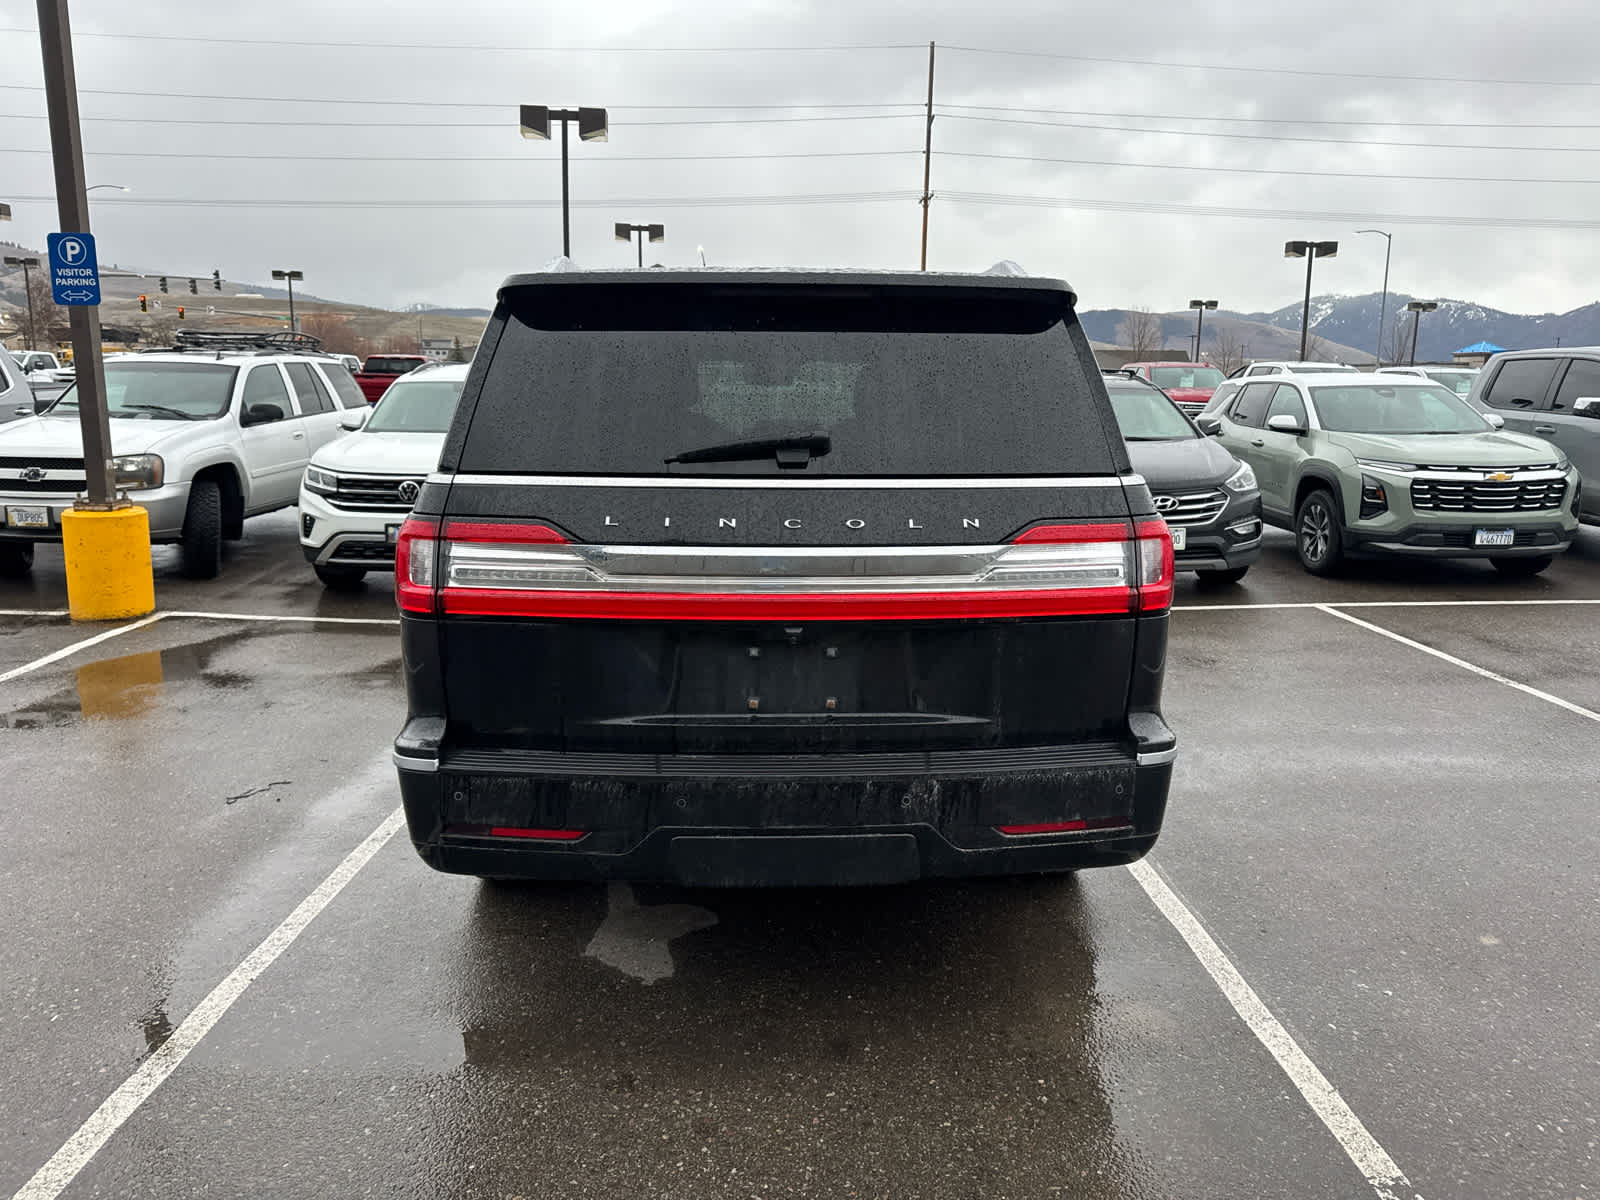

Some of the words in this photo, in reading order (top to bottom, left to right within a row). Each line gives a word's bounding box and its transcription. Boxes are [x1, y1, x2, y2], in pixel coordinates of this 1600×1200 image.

[65, 241, 81, 262] P
[56, 268, 94, 277] VISITOR
[55, 278, 97, 287] PARKING
[605, 515, 980, 530] LINCOLN
